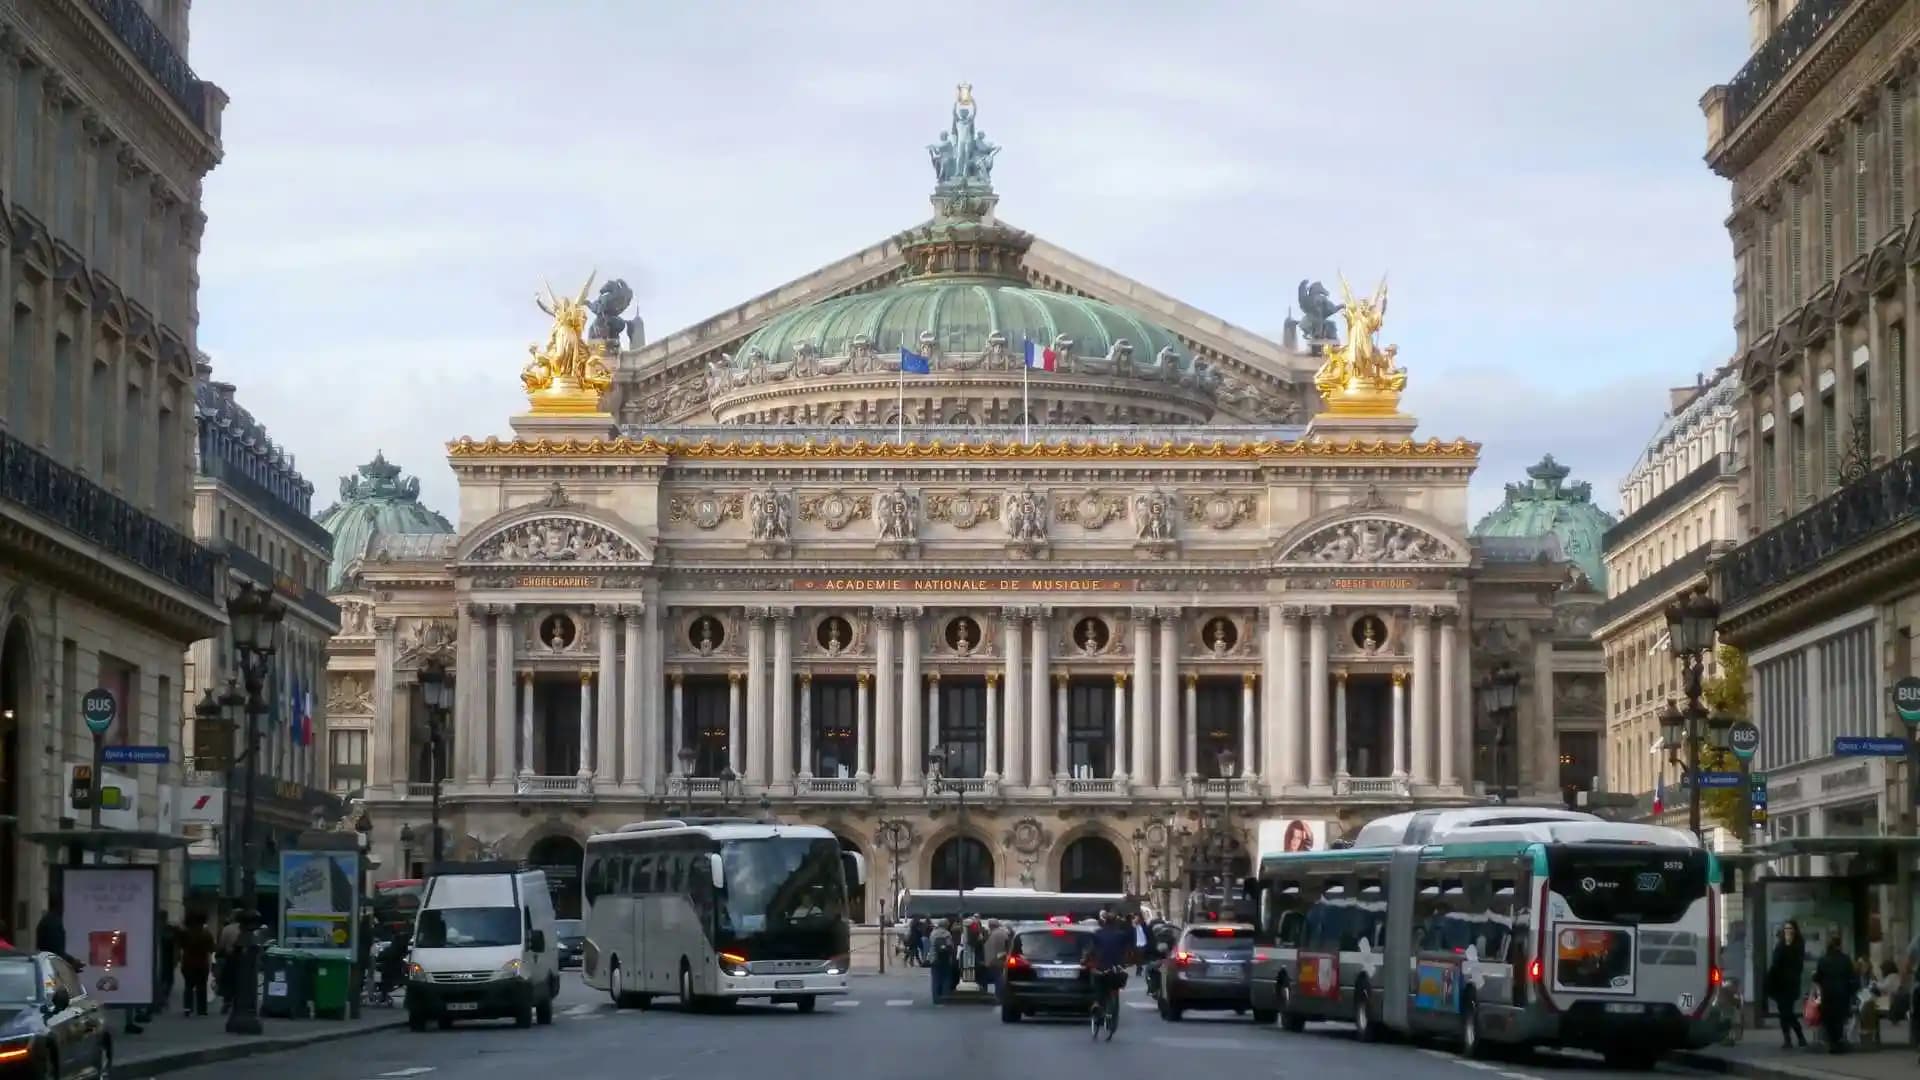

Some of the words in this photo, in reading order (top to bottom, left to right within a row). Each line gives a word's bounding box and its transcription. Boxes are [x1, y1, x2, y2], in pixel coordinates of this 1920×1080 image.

[702, 503, 711, 513] N
[767, 504, 774, 513] E
[1153, 504, 1160, 513] E
[826, 579, 900, 590] ACADEMIE
[914, 579, 987, 590] NATIONALE
[1000, 579, 1020, 590] DE
[1032, 579, 1101, 590] MUSIQUE
[87, 698, 112, 711] BUS
[1733, 729, 1756, 742] BUS
[1681, 993, 1693, 1008] 70
